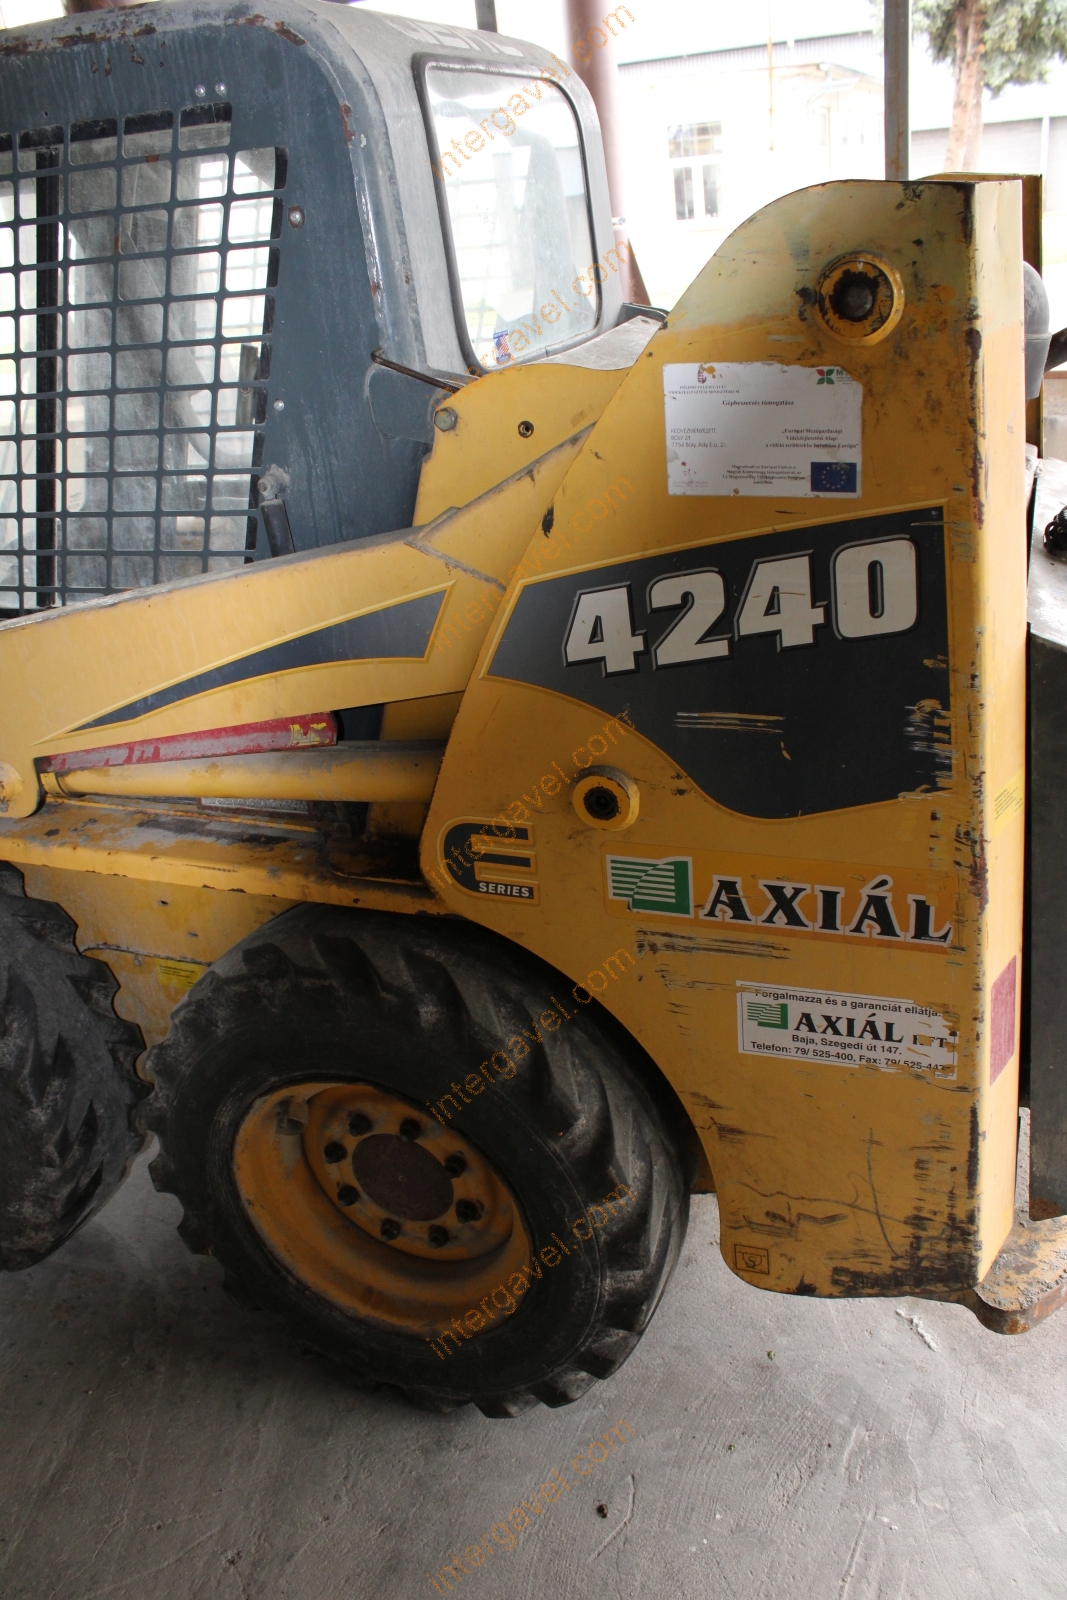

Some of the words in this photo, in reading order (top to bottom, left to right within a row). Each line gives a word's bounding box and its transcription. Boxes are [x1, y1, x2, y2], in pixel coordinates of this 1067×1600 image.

[562, 534, 921, 678] 4240
[479, 882, 530, 898] SERIES
[701, 876, 953, 944] AXIÁL
[755, 989, 822, 1004] Forgalmazza
[825, 997, 838, 1006] és
[850, 1000, 902, 1013] garanciát
[794, 1012, 904, 1044] AXIÁL
[751, 1041, 792, 1054] Telefon:
[794, 1046, 810, 1056] 79/
[813, 1049, 856, 1062] 525-400,
[859, 1054, 881, 1065] Fax:
[792, 1034, 818, 1046] Baja,
[821, 1037, 863, 1050] Szegedi
[866, 1042, 877, 1052] út
[880, 1045, 902, 1055] 147.
